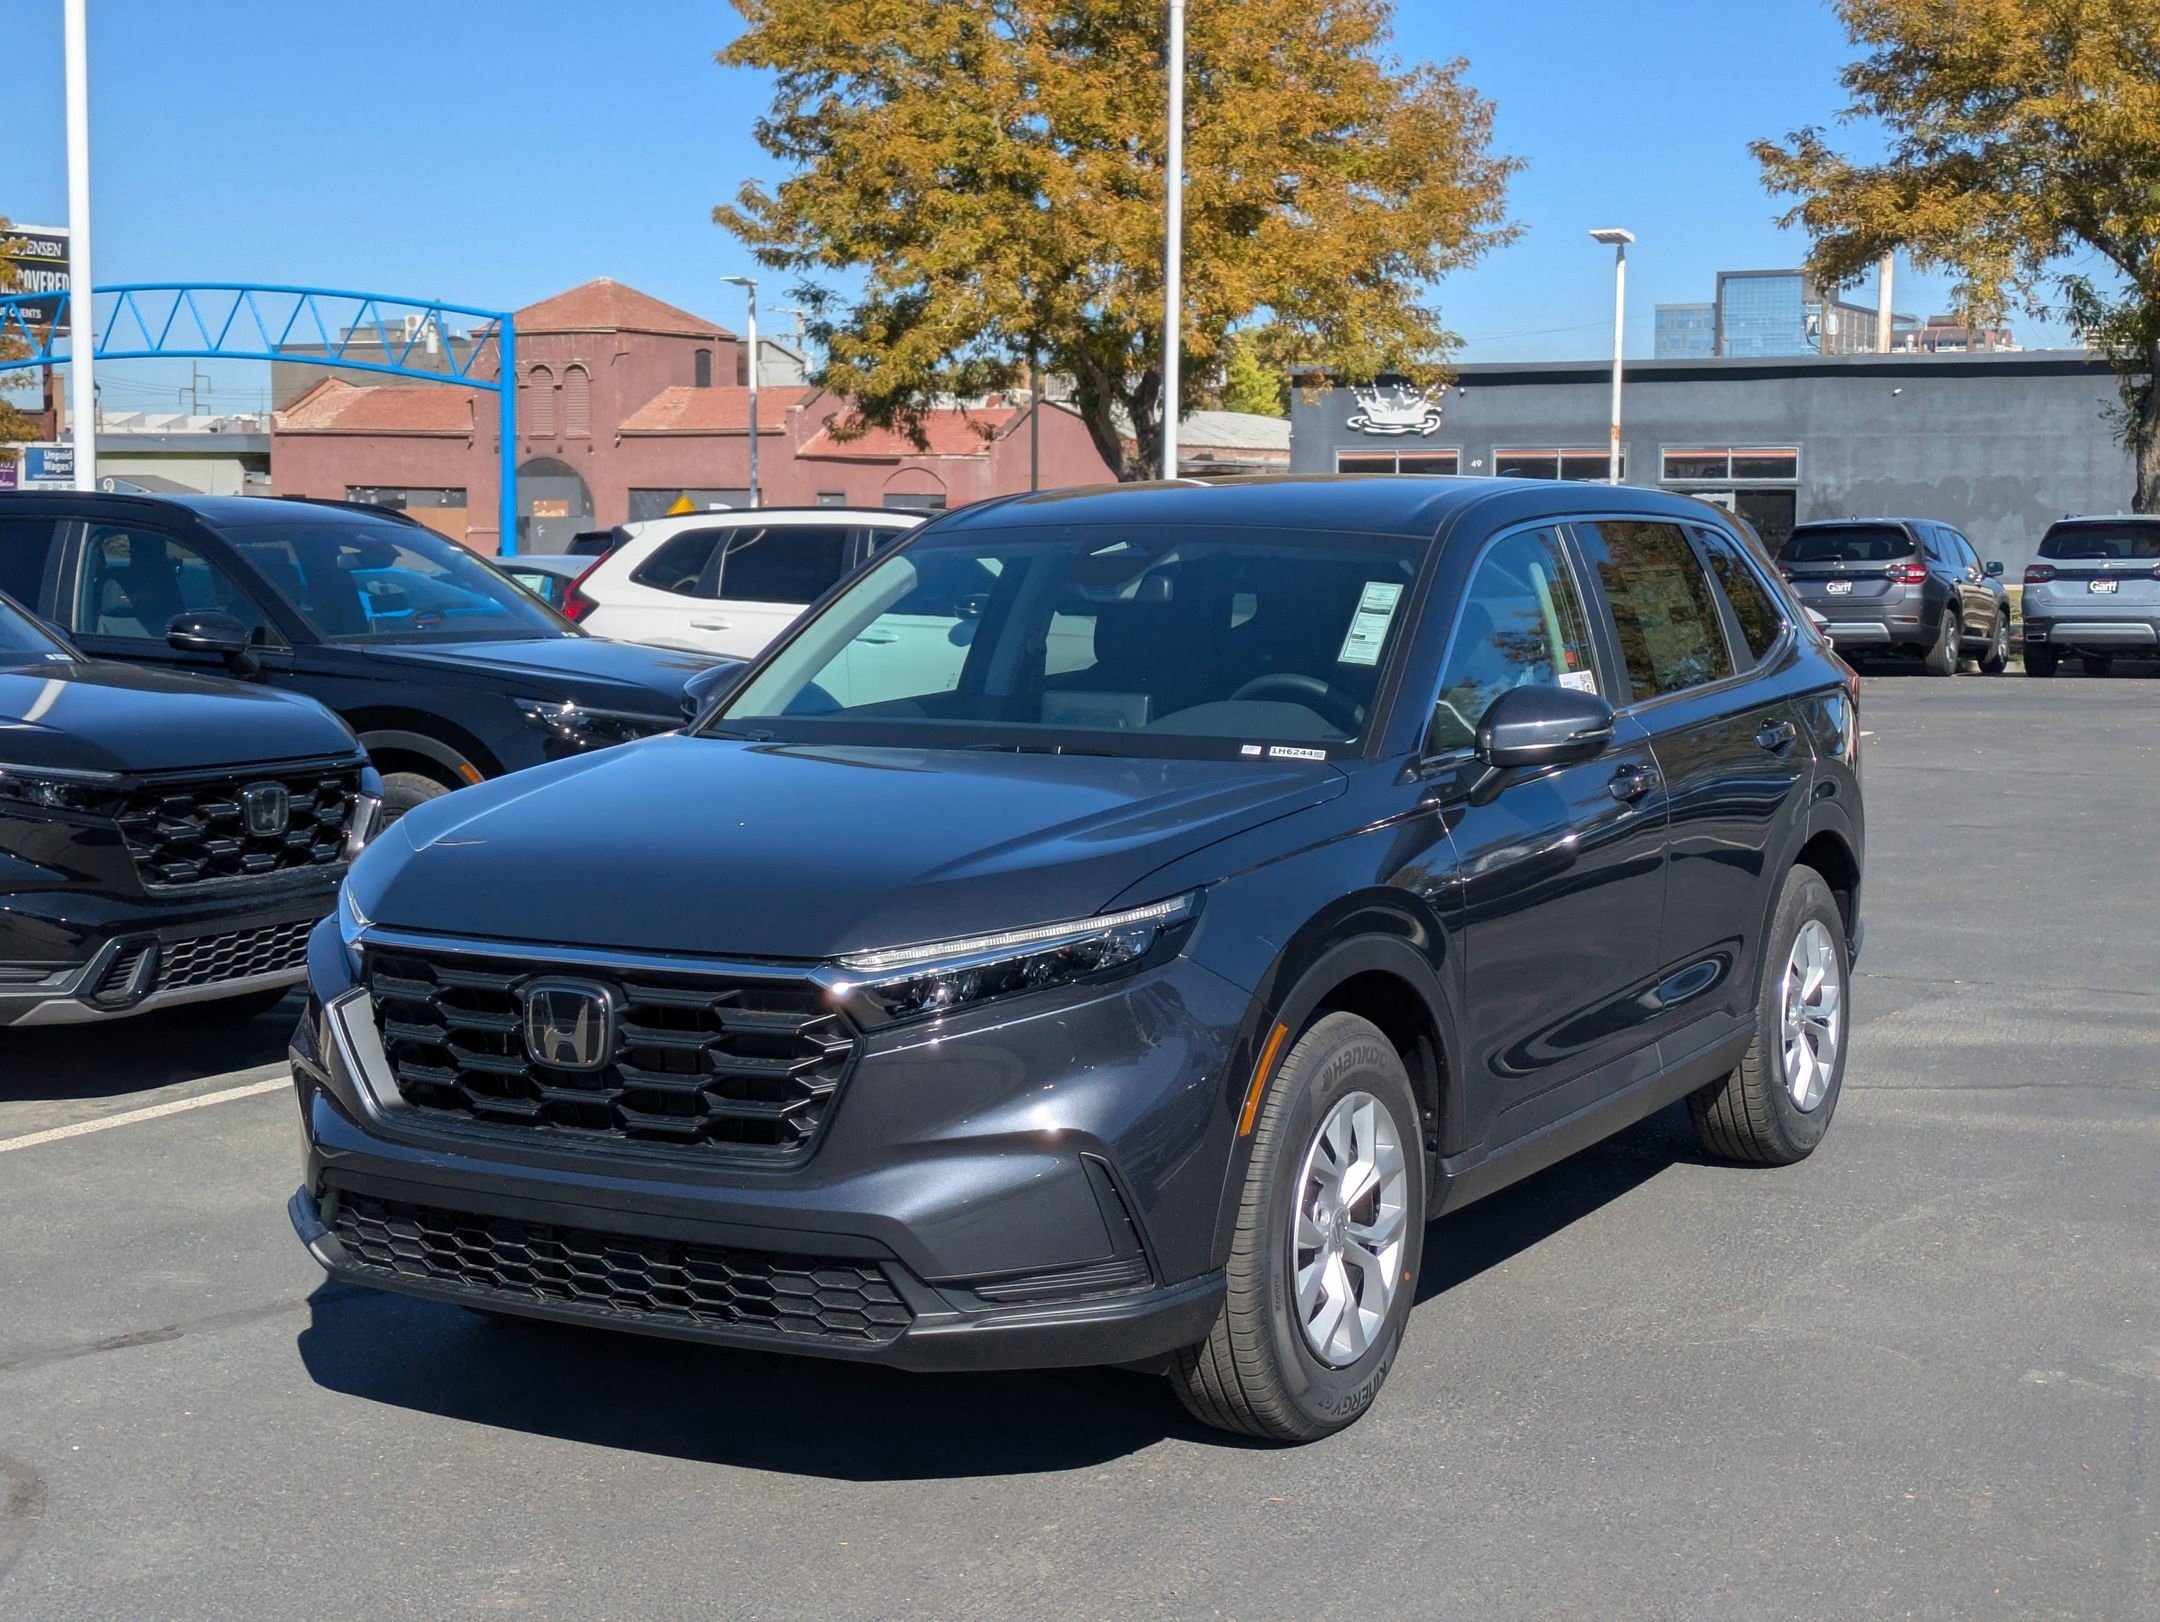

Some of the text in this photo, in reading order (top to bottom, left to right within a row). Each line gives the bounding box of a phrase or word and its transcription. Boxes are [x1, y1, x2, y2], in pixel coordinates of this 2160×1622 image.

[1, 268, 69, 293] COVERED
[44, 449, 73, 462] Unpaid
[1272, 747, 1313, 757] 1H6244
